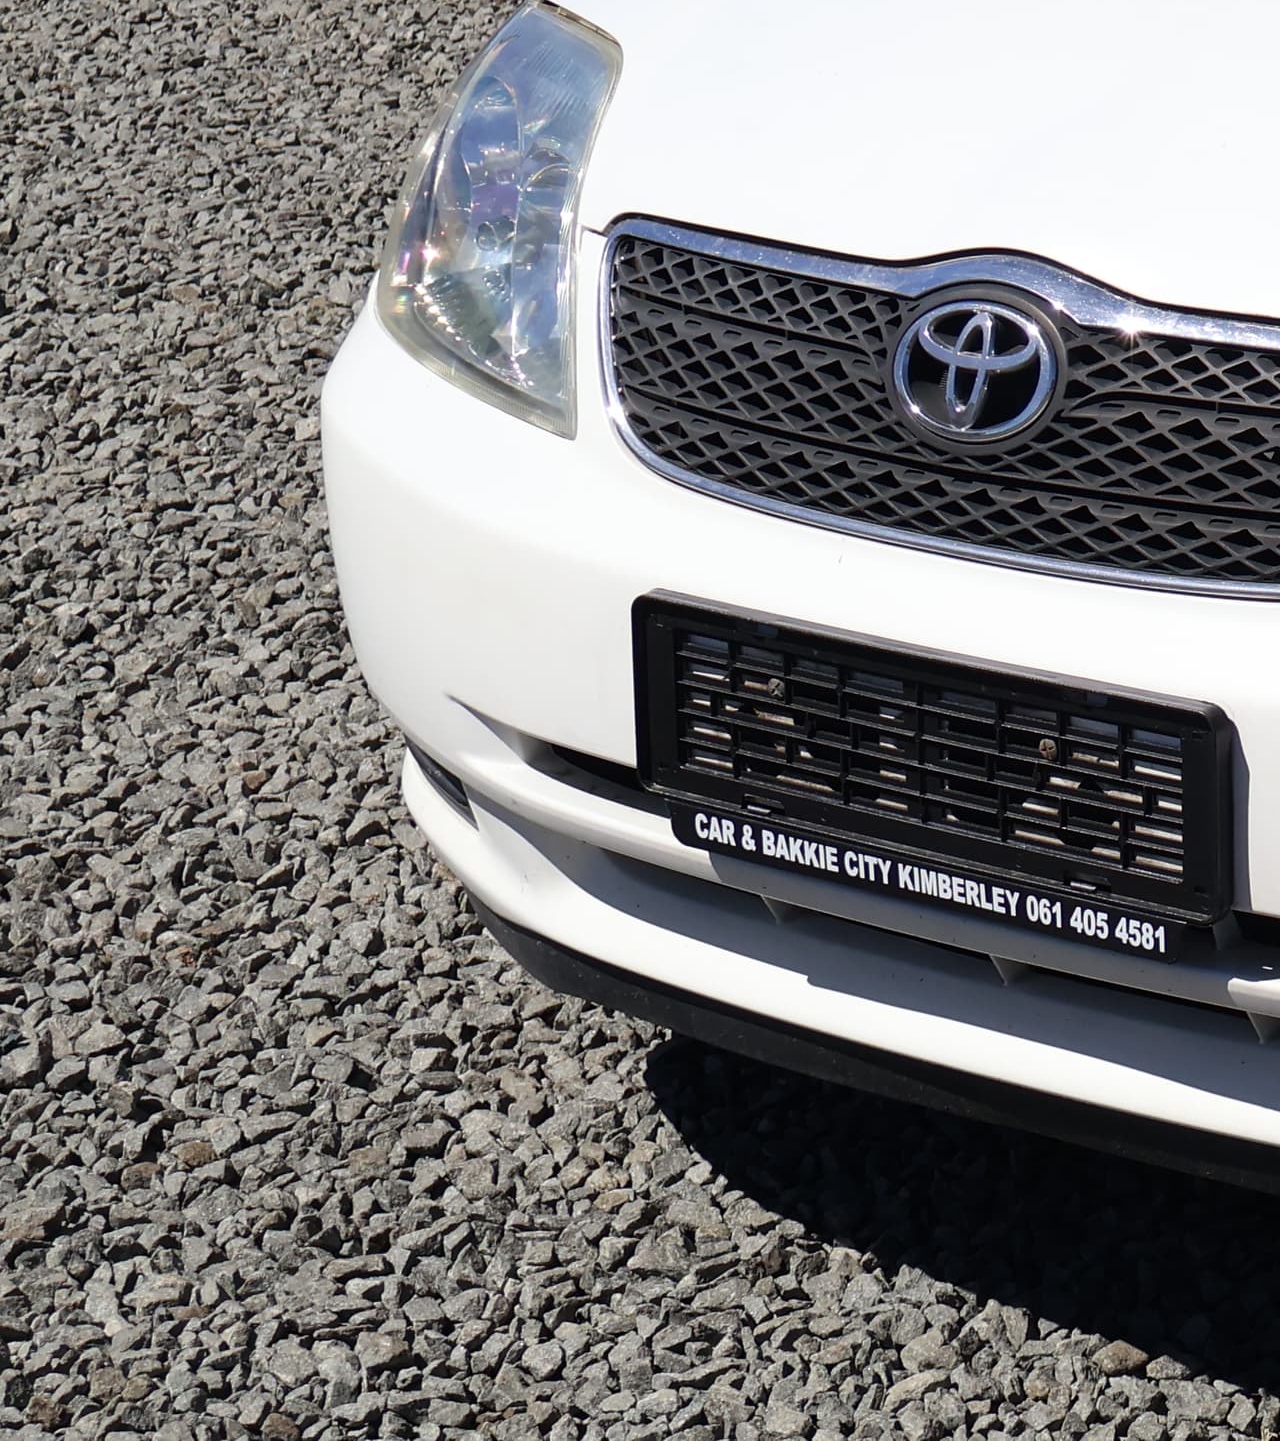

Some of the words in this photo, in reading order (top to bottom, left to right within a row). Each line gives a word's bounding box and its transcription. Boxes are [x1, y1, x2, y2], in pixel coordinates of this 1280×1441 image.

[695, 813, 736, 847] CAR
[741, 824, 757, 852] &
[761, 829, 840, 873] BAKKIE
[844, 850, 892, 885] CITY
[898, 863, 1020, 917] KIMBERLEY
[1026, 895, 1063, 929] 061
[1070, 906, 1109, 940] 405
[1115, 917, 1166, 953] 4581
